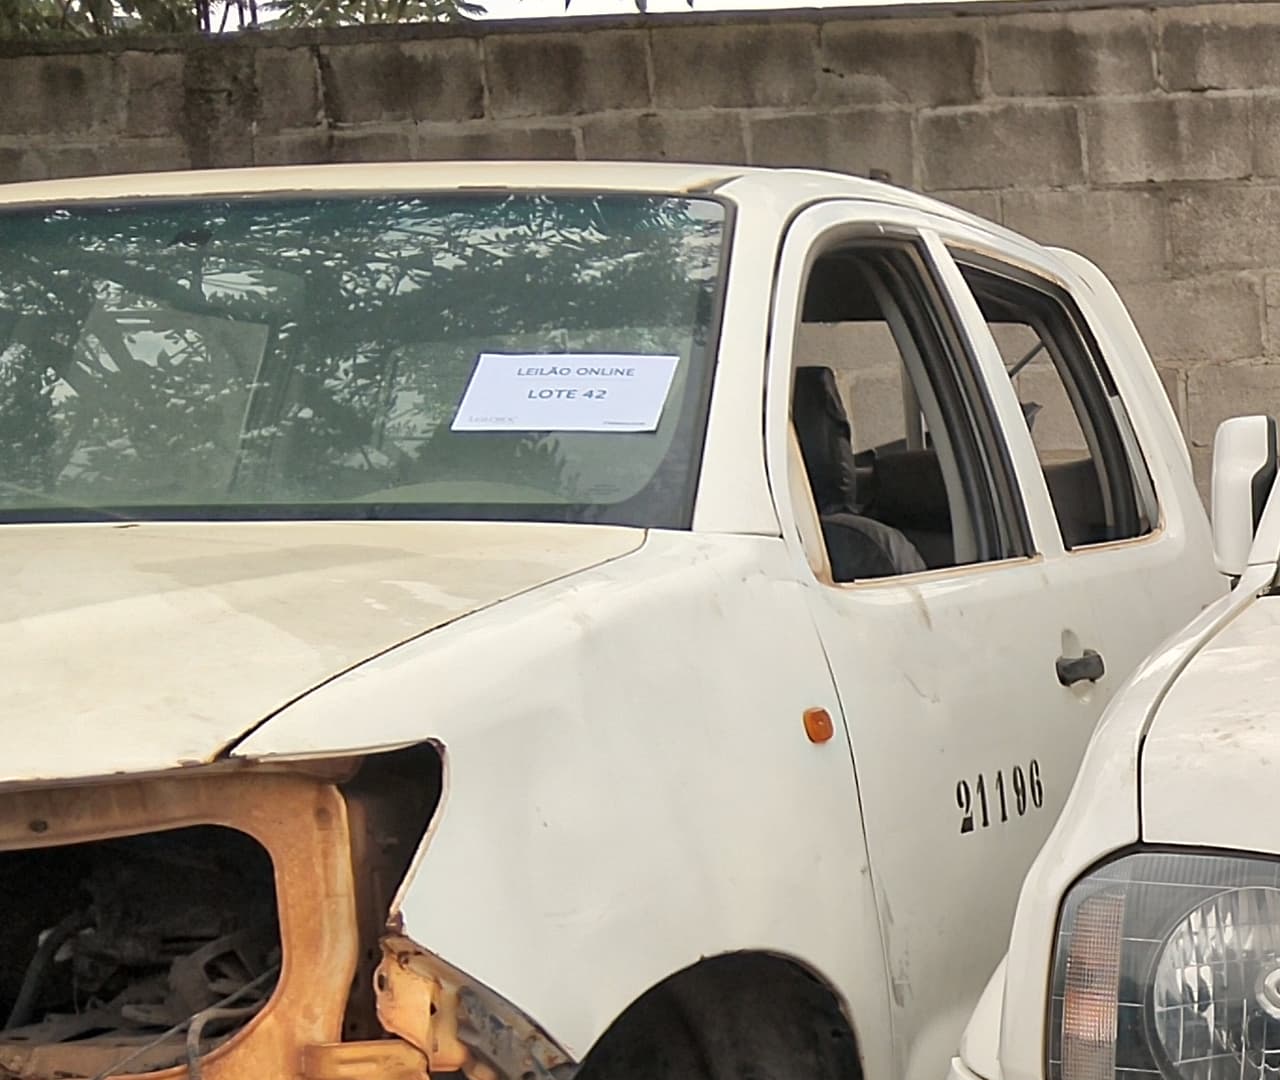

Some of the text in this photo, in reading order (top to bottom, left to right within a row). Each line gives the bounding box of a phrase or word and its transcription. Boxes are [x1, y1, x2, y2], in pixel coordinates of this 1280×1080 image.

[516, 366, 636, 377] LEILÃO ONLINE
[527, 389, 608, 400] LOTE 42
[956, 759, 1043, 834] 21196
